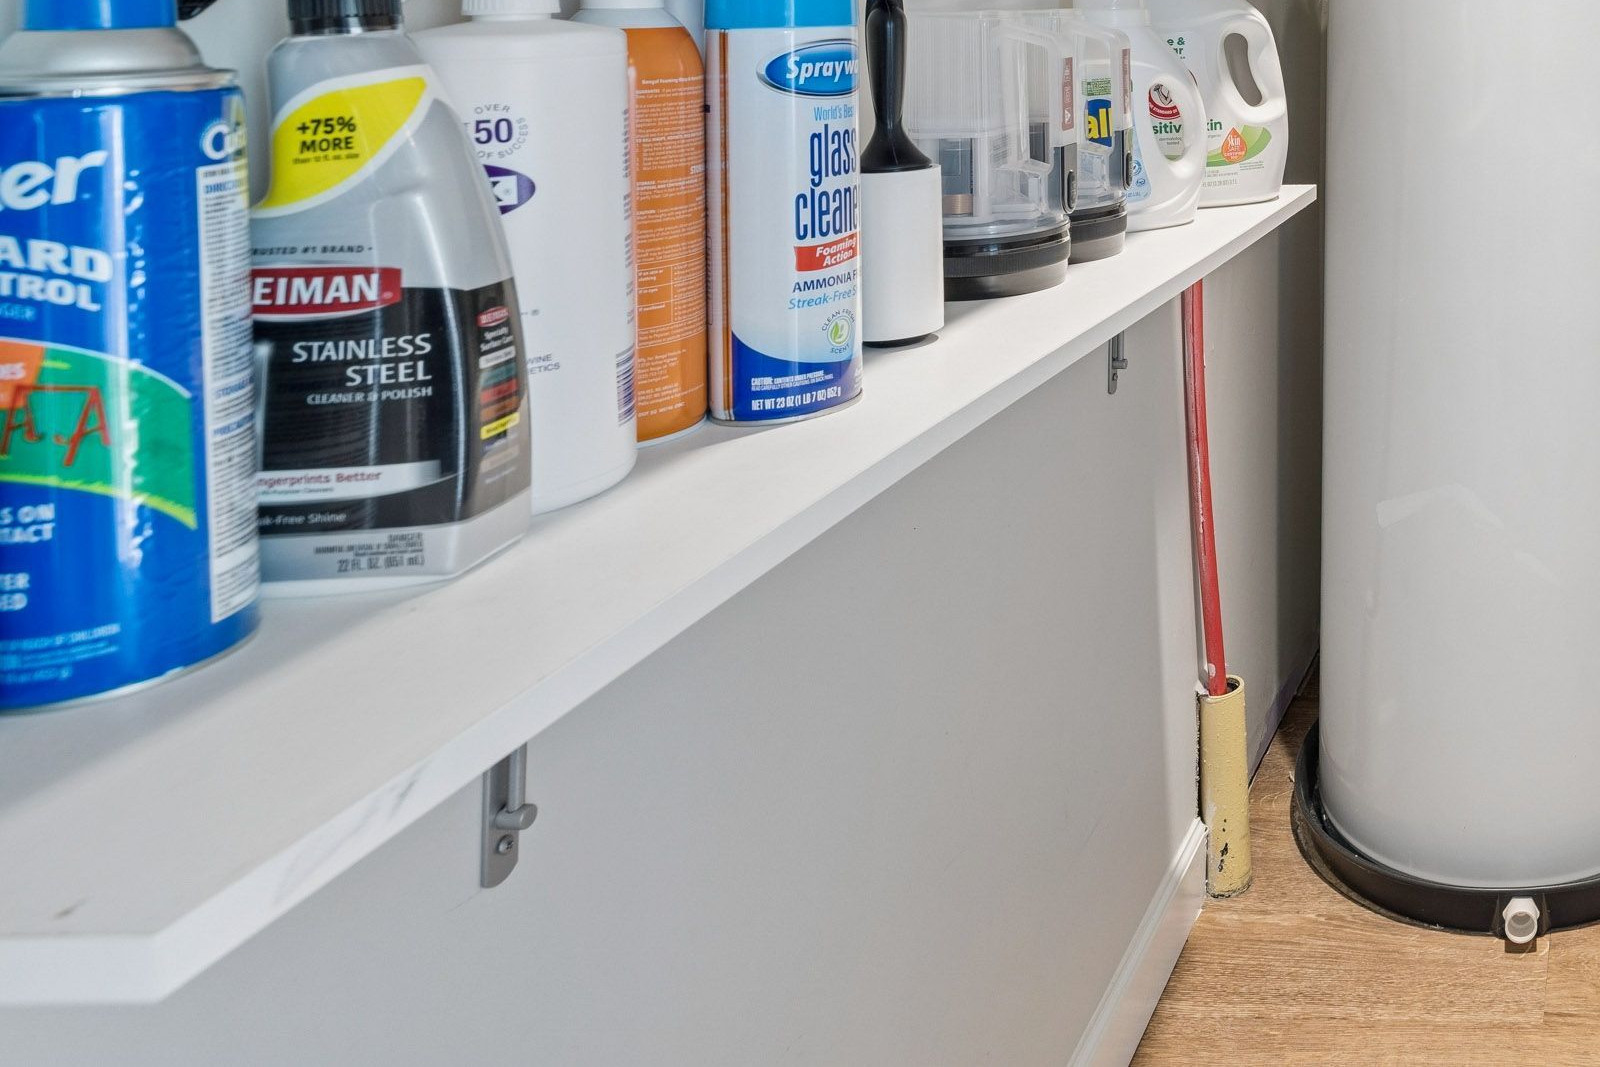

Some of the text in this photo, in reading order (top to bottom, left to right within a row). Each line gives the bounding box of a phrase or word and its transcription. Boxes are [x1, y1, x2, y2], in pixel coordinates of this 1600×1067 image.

[474, 103, 511, 114] OVER
[813, 106, 842, 121] World's
[297, 116, 357, 136] +75%
[474, 118, 513, 144] 50
[1087, 107, 1113, 140] all
[299, 136, 354, 154] MORE
[809, 124, 857, 188] glass
[321, 244, 364, 255] BRAND
[815, 236, 857, 258] Foaming
[822, 249, 853, 267] Action
[792, 271, 852, 293] AMMONIA
[787, 290, 852, 310] Streak-Free
[291, 333, 433, 363] STAINLESS
[345, 360, 433, 387] STEEL
[306, 389, 367, 406] CLEANER
[381, 385, 433, 402] POLISH
[751, 399, 763, 410] NET
[764, 398, 775, 409] WT
[776, 397, 785, 409] 23
[786, 396, 795, 407] OZ
[803, 392, 811, 405] LB
[335, 472, 382, 483] Better
[307, 512, 348, 524] Shine
